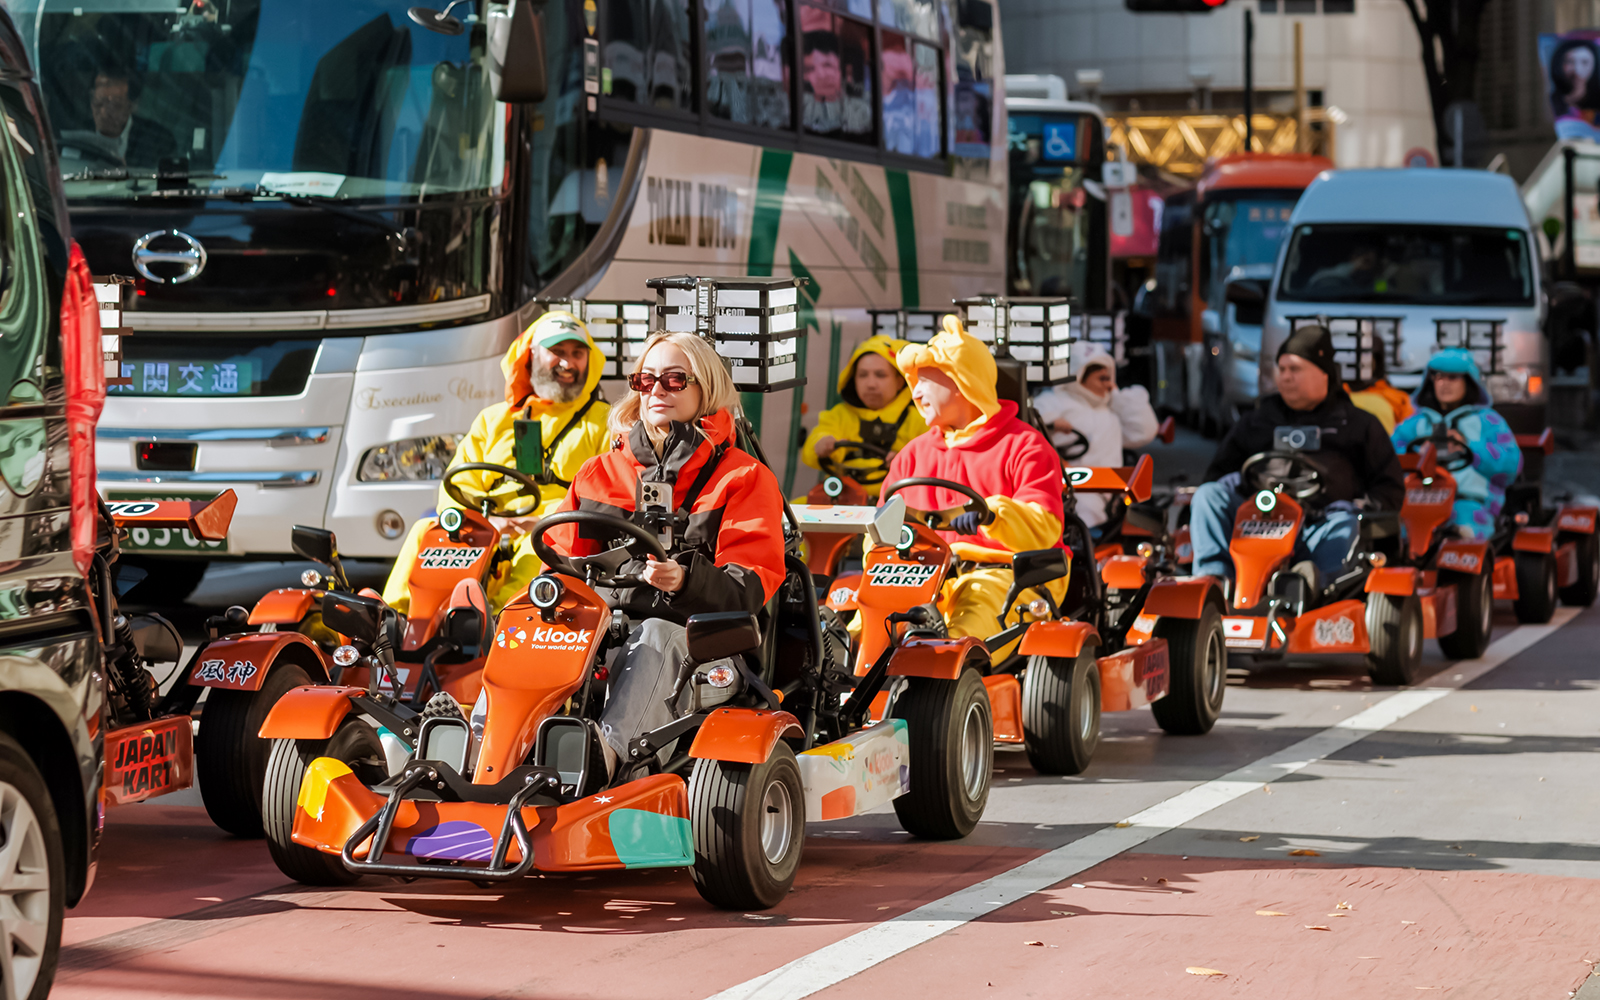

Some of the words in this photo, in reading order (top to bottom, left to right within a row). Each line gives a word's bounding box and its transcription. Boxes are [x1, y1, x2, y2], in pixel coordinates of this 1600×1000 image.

[355, 386, 444, 411] Executive
[419, 547, 484, 558] JAPAN
[422, 558, 475, 568] KART
[869, 564, 938, 575] JAPAN
[872, 575, 929, 586] KART
[532, 627, 591, 643] klook
[195, 659, 258, 686] 風神
[114, 728, 178, 770] JAPAN
[121, 758, 174, 798] KART
